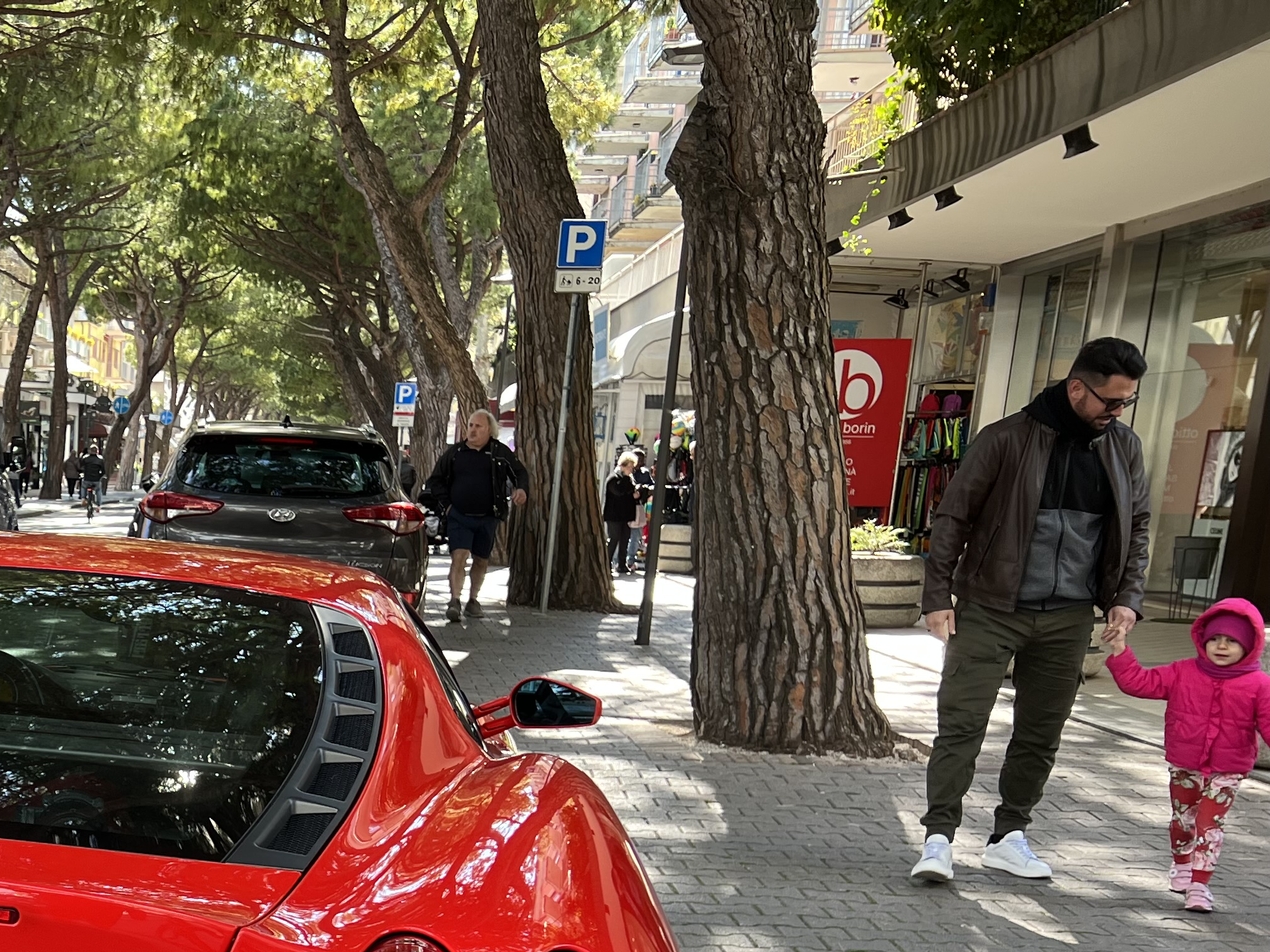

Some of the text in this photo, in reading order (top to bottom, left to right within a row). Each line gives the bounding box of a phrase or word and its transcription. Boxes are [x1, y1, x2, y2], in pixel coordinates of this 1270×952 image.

[566, 225, 597, 263] P
[398, 385, 413, 403] P
[842, 421, 877, 434] borin
